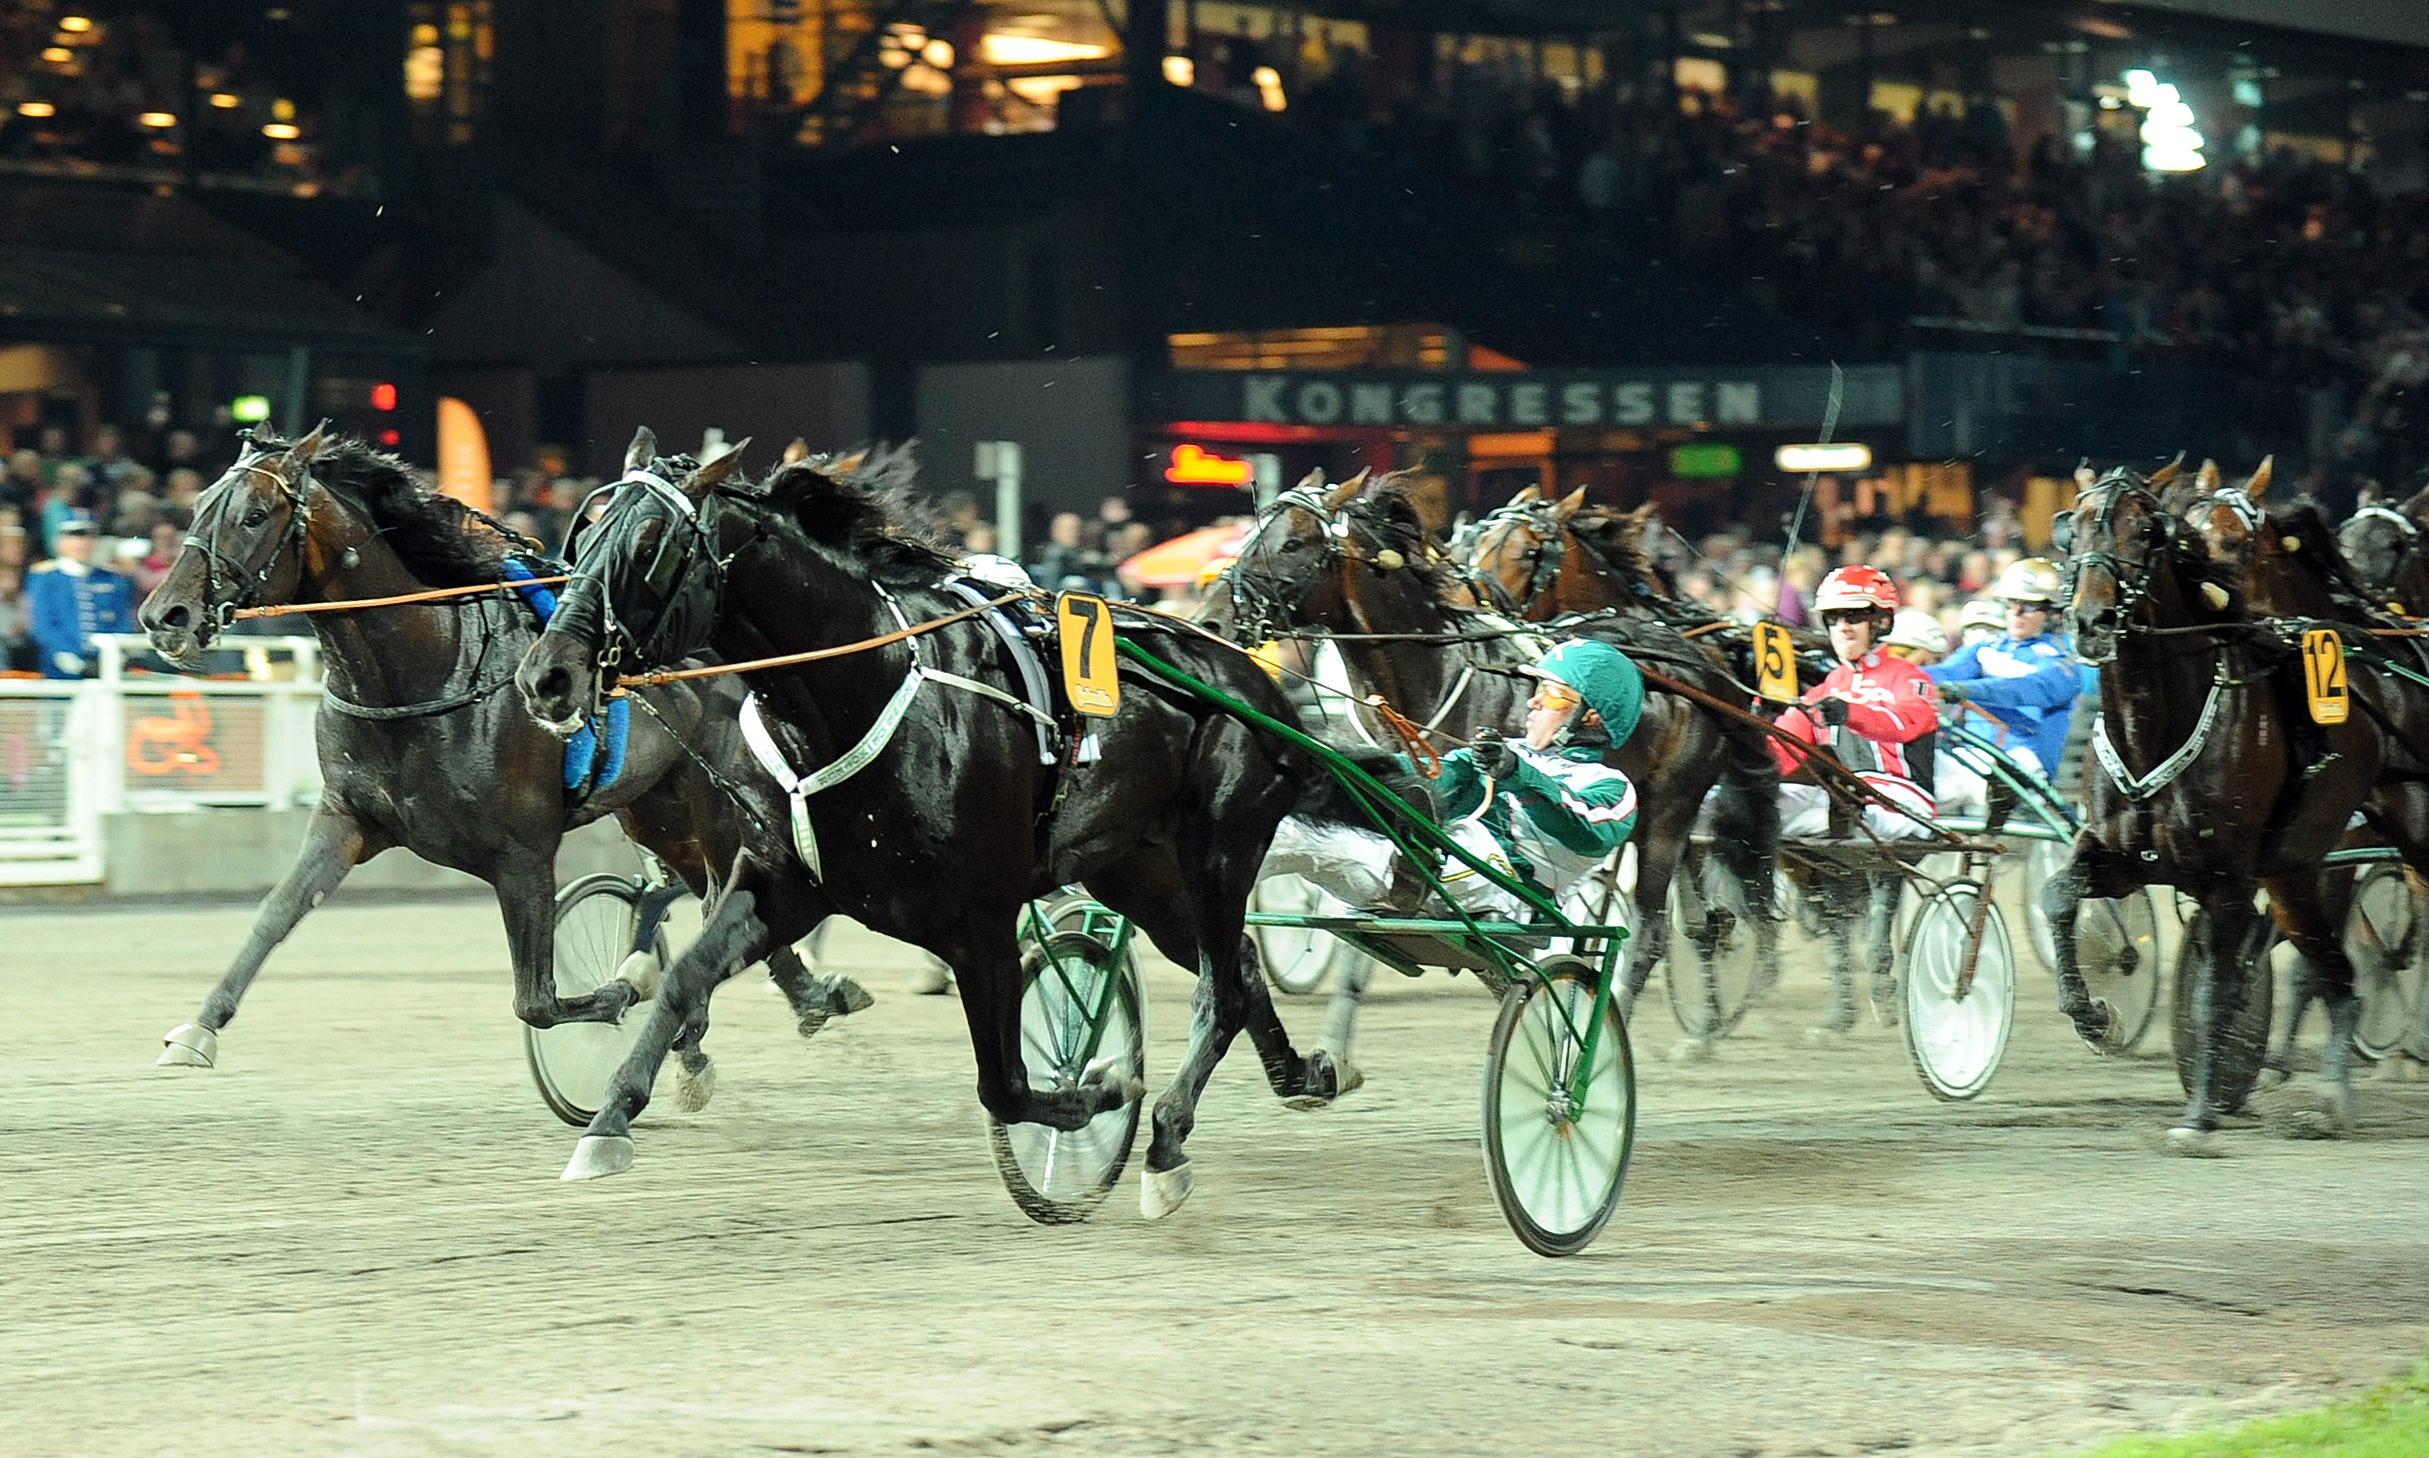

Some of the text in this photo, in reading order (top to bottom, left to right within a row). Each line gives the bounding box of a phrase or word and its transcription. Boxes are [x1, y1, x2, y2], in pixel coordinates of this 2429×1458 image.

[1243, 376, 1759, 425] KONGRESSEN
[1068, 598, 1098, 679] 7
[1764, 627, 1783, 679] 5
[2308, 632, 2342, 697] 12
